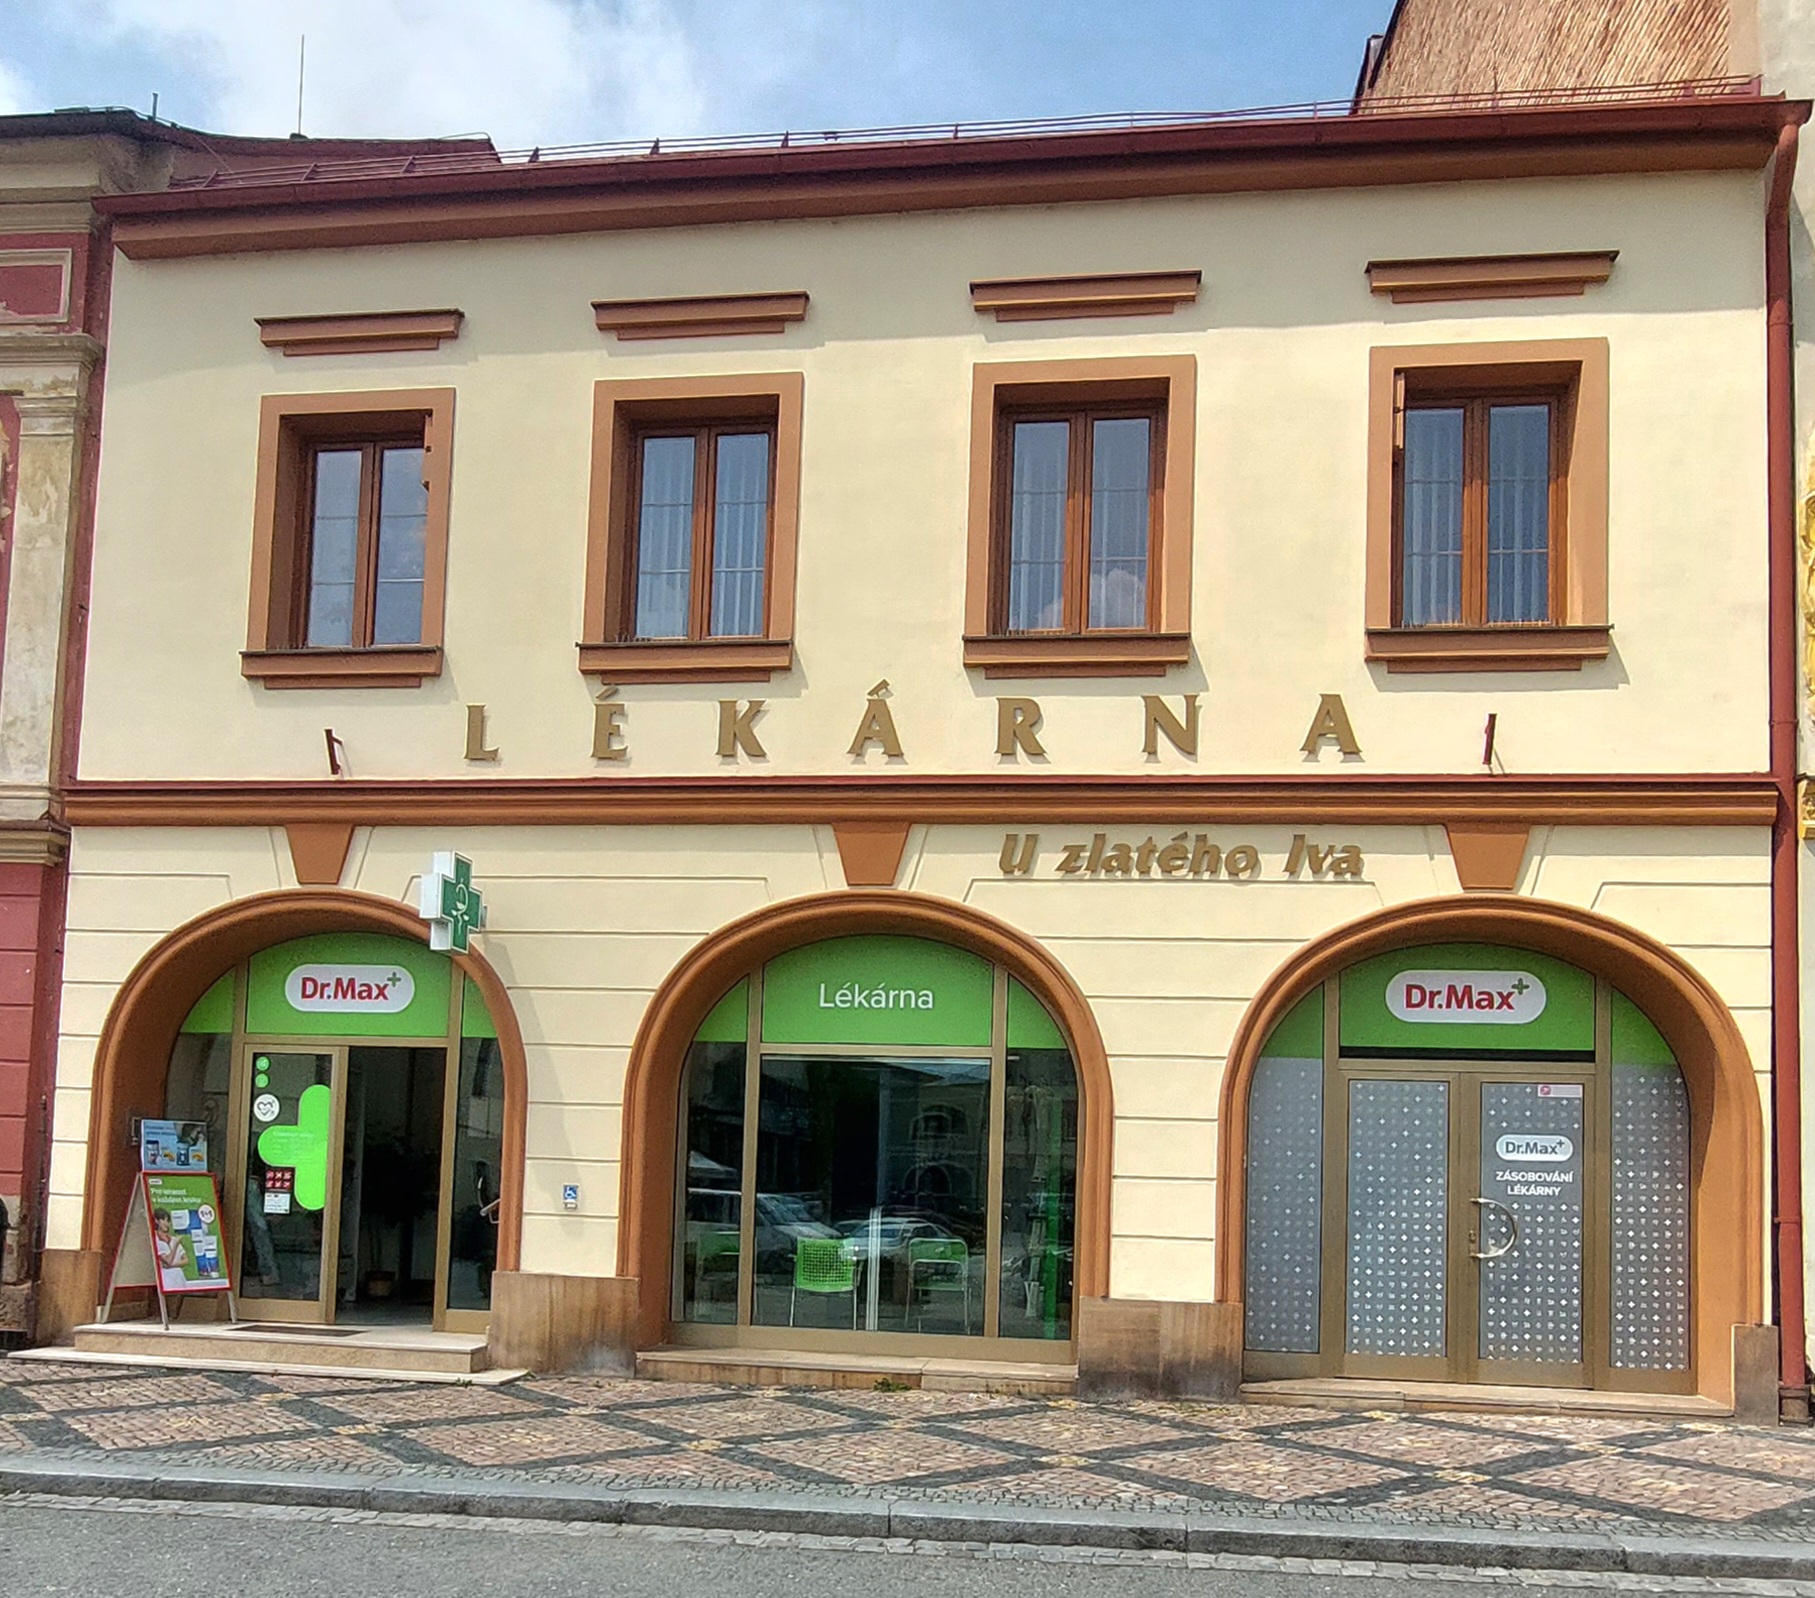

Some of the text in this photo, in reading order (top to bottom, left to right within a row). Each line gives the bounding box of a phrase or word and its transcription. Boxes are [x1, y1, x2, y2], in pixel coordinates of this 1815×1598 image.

[464, 679, 1363, 761] LÉKÁRNA
[999, 833, 1039, 875] U
[1055, 831, 1260, 876] zlatého
[819, 981, 934, 1009] Lékárna
[1495, 1170, 1574, 1182] ZÁSOBOVÁNÍ
[1507, 1184, 1561, 1196] LÉKÁRNY
